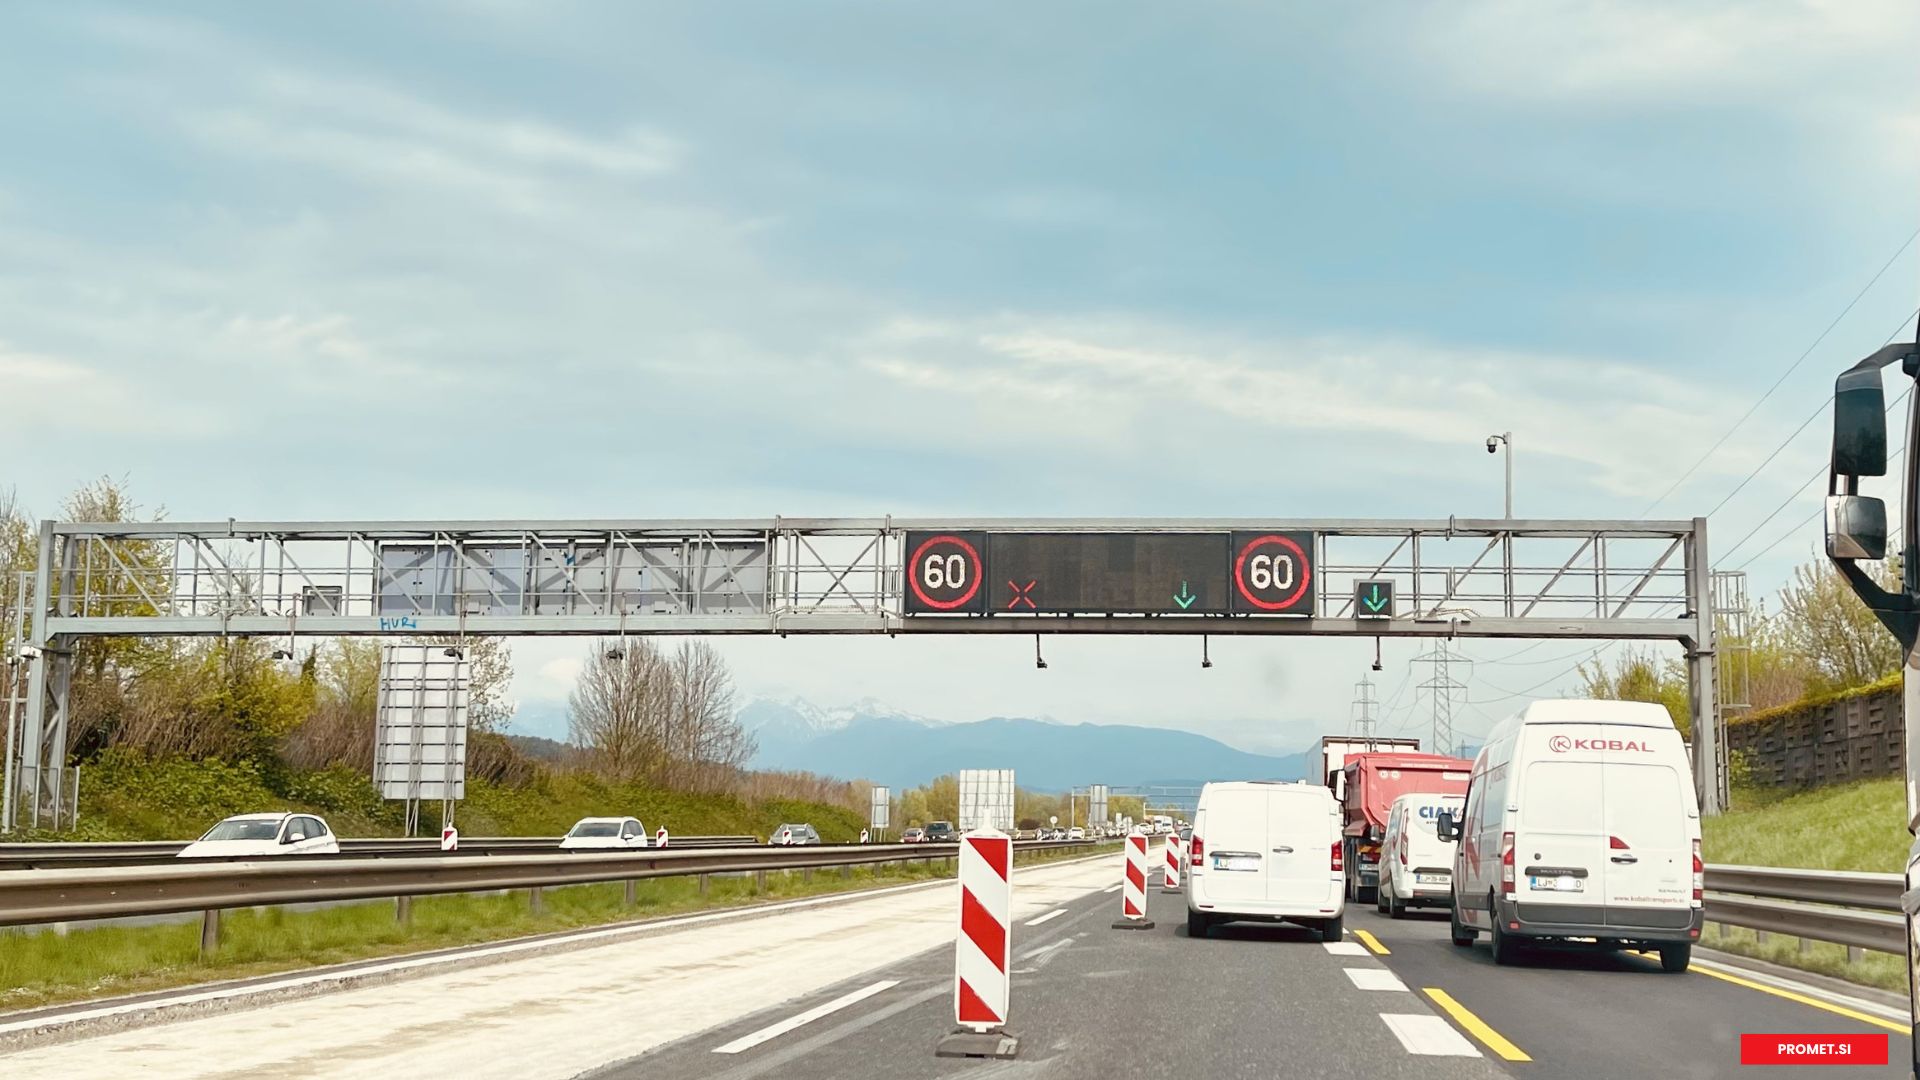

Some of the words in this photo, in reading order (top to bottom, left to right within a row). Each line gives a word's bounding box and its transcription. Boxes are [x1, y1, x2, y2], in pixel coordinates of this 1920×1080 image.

[925, 554, 966, 589] 60
[1251, 554, 1293, 590] 60
[1575, 739, 1655, 752] KOBAL
[1537, 879, 1548, 887] LJ
